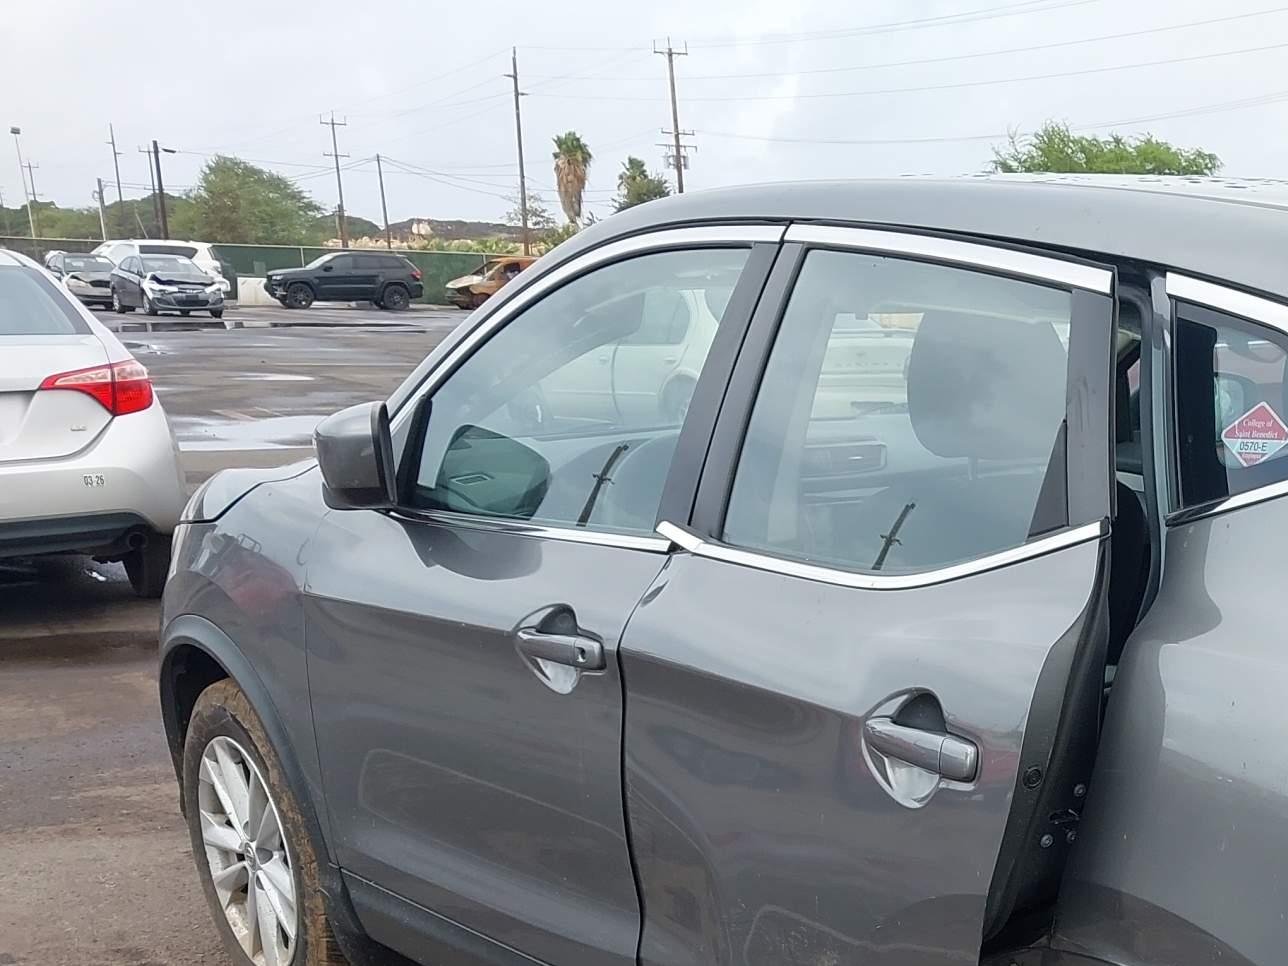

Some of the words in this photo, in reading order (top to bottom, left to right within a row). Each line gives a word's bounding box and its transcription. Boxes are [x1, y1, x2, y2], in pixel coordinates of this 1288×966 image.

[1243, 418, 1265, 428] College
[1266, 419, 1273, 427] of
[1235, 429, 1250, 438] Saint
[1251, 430, 1278, 438] Benedict
[1240, 441, 1268, 451] 0570-E
[84, 475, 94, 486] 03
